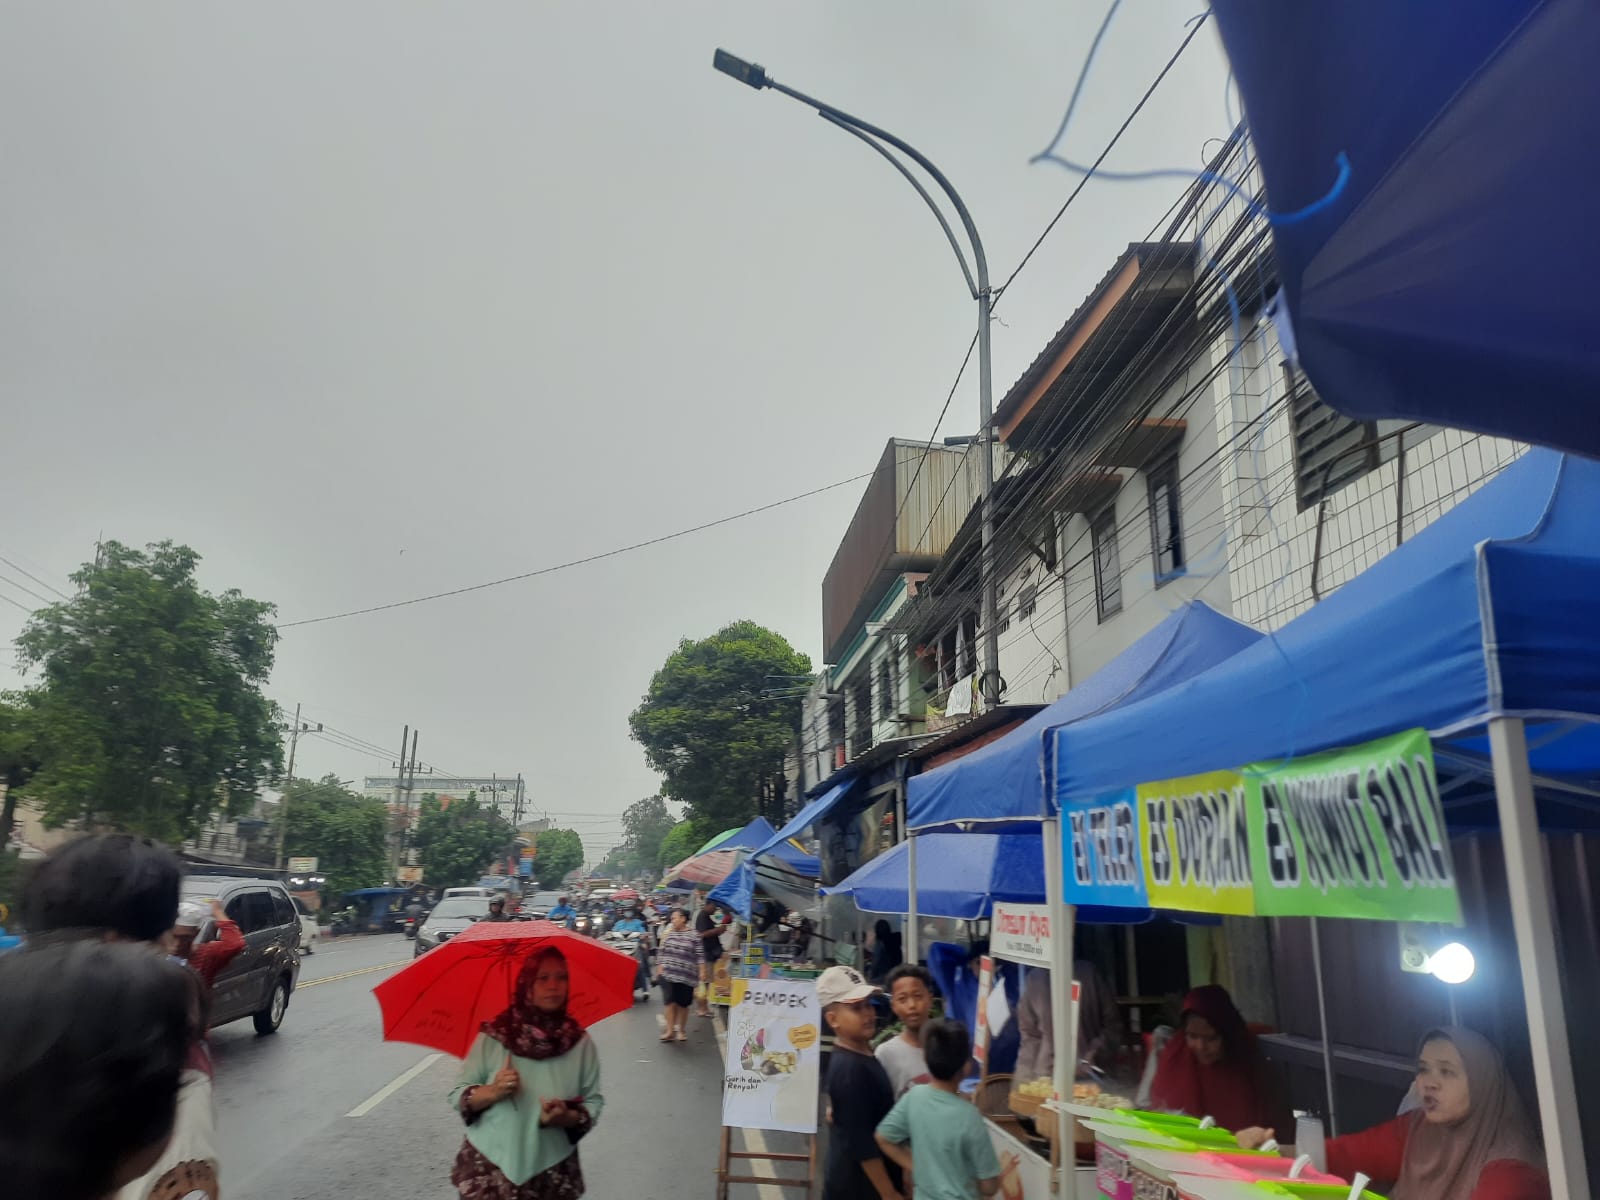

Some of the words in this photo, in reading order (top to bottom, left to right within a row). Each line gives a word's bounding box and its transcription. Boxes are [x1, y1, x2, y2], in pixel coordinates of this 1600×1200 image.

[1069, 811, 1092, 885] ES
[1146, 797, 1172, 885] ES
[1171, 786, 1252, 893] DURIAN
[1261, 778, 1300, 888] ES
[744, 991, 808, 1008] PEMPEK
[726, 1075, 746, 1083] Gurih
[748, 1076, 761, 1084] dan
